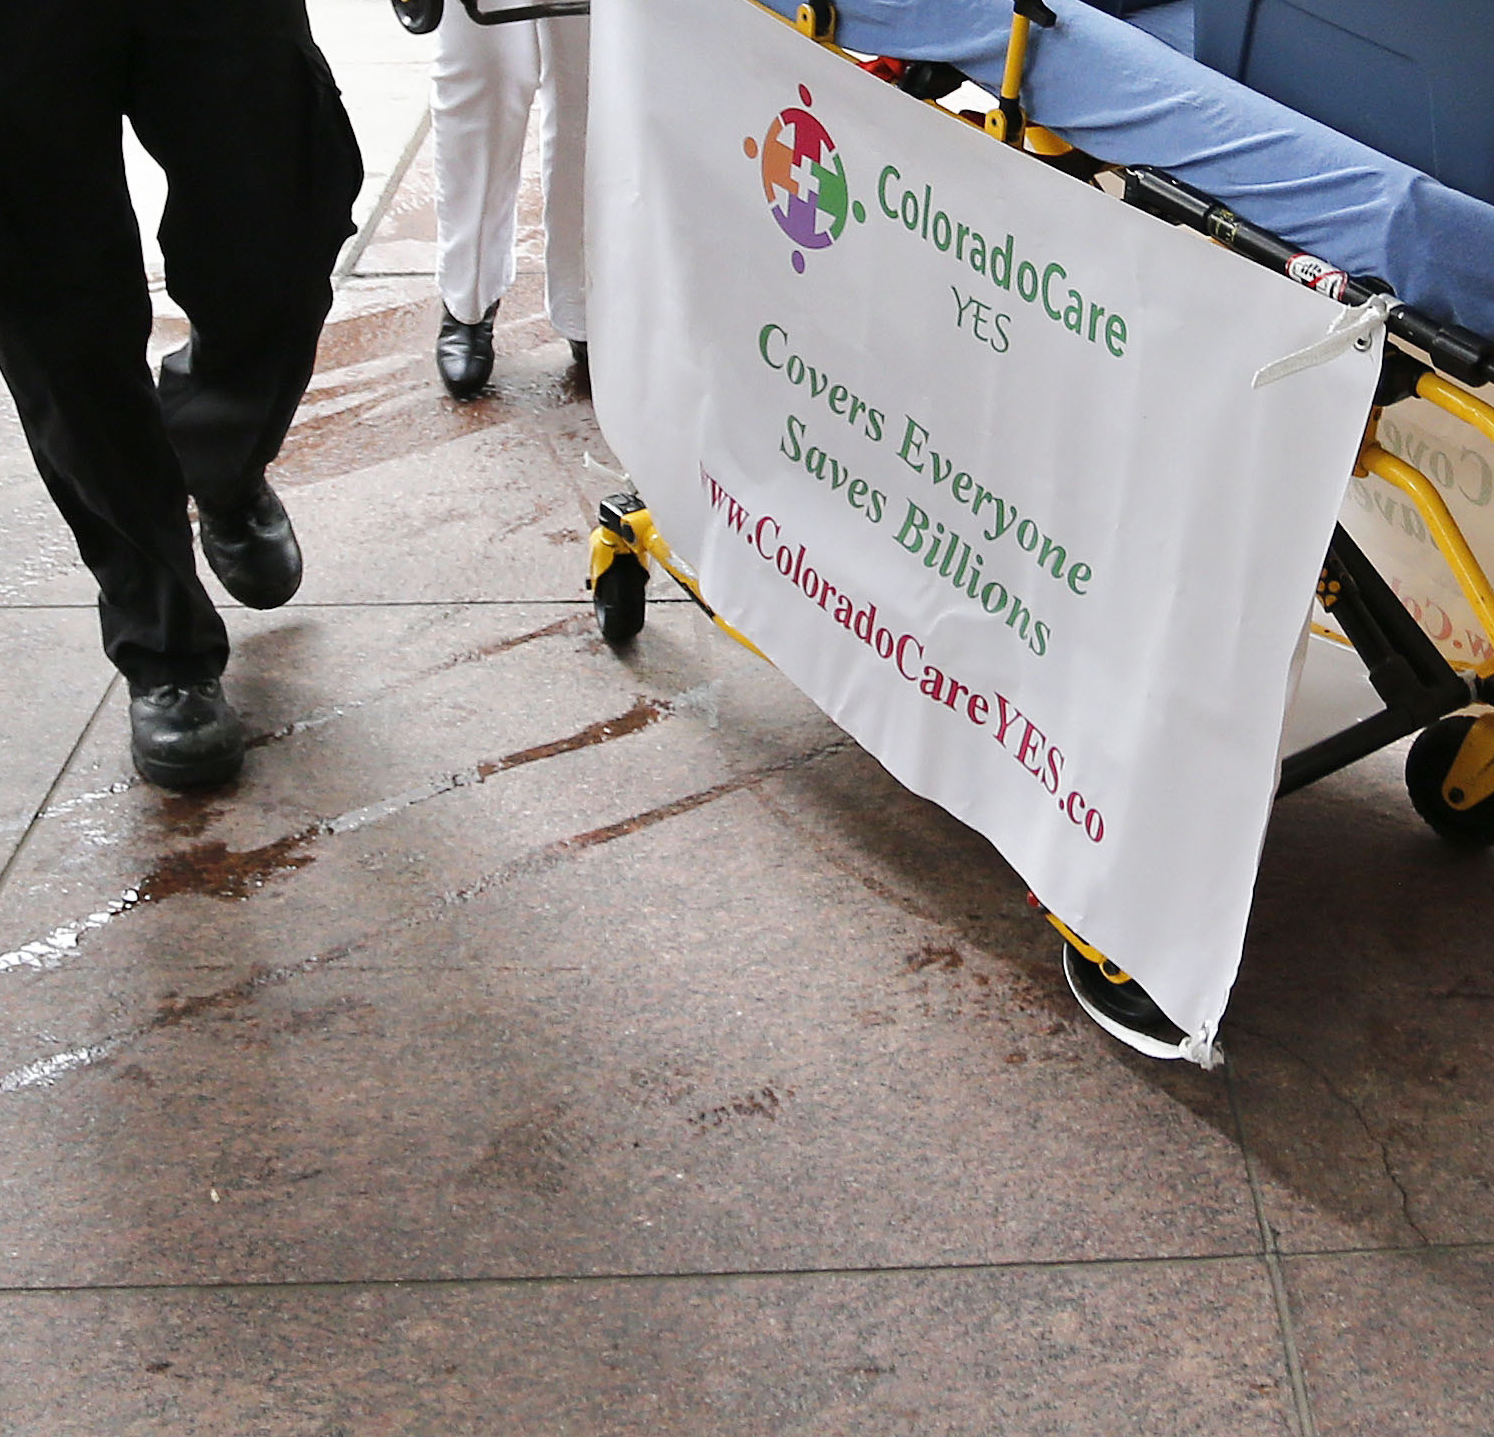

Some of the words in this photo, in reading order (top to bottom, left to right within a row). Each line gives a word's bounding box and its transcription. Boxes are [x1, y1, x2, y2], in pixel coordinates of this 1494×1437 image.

[878, 165, 1128, 357] ColoradoCare
[950, 285, 1012, 353] YES
[758, 323, 886, 443] Covers
[895, 414, 1093, 596] Everyone
[779, 414, 888, 524] Saves
[891, 497, 1052, 657] Billions
